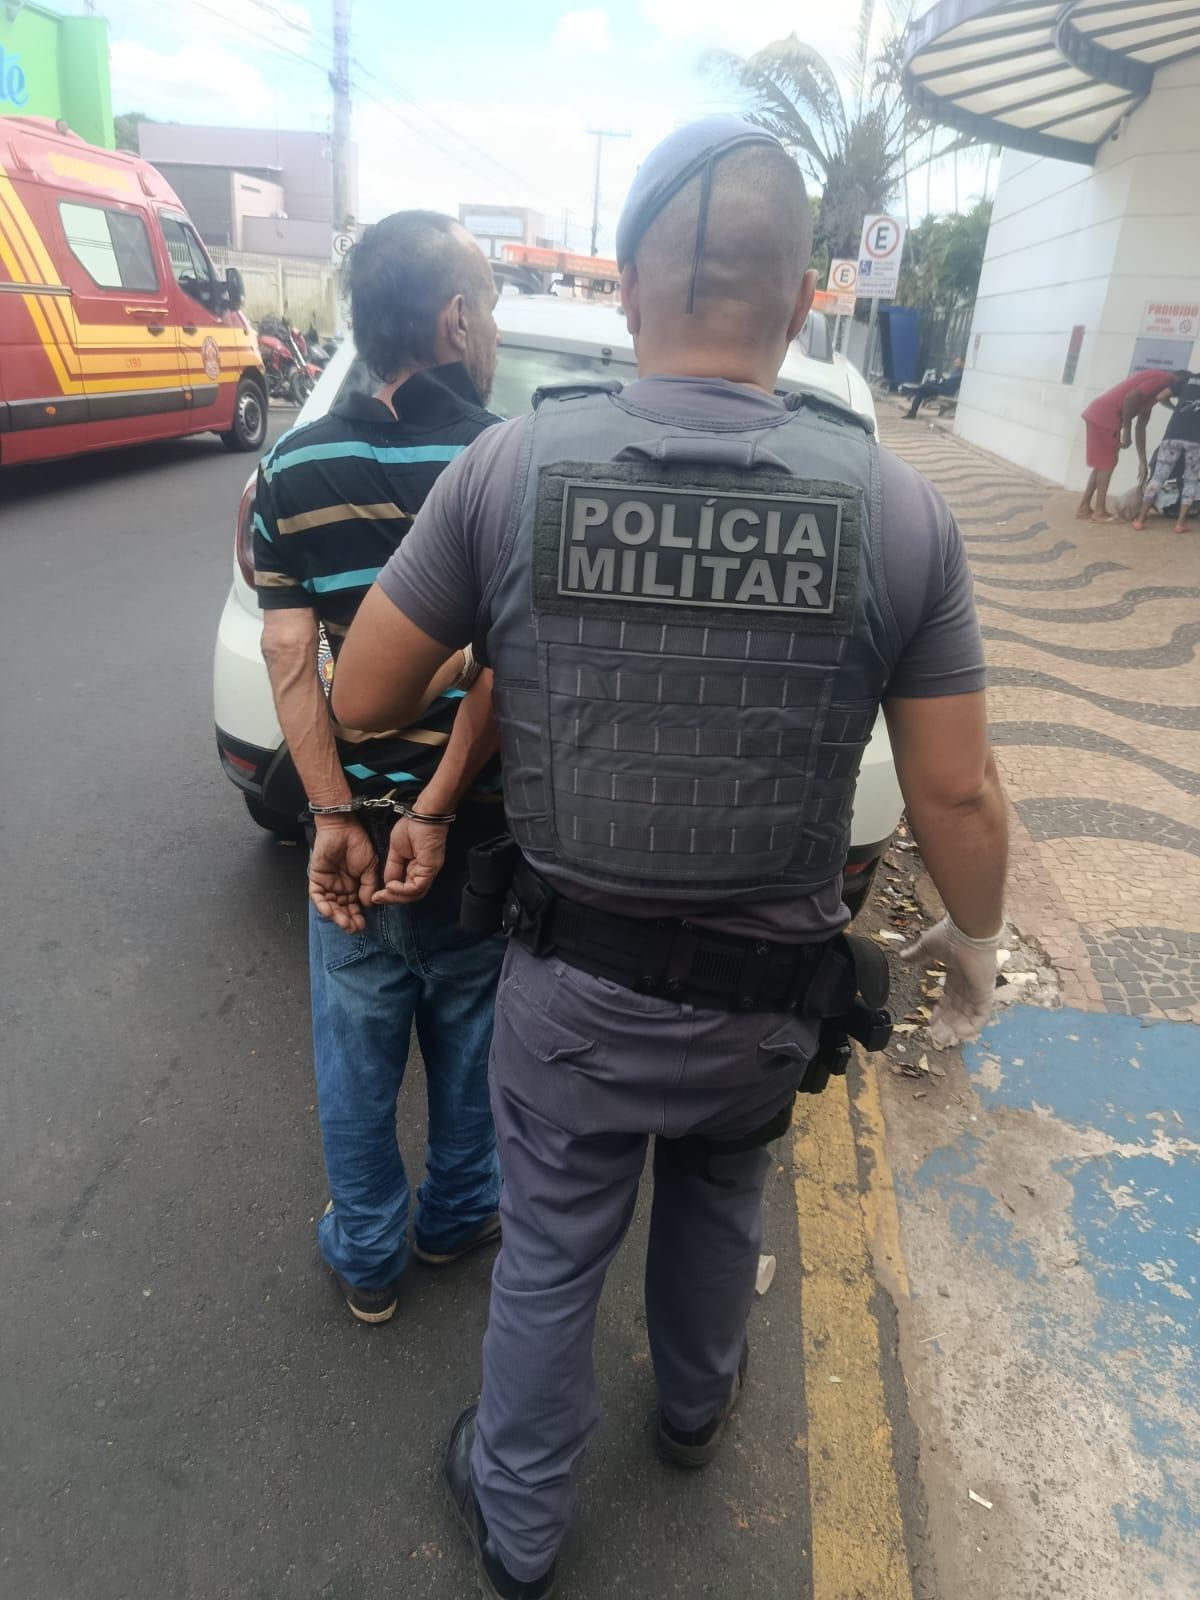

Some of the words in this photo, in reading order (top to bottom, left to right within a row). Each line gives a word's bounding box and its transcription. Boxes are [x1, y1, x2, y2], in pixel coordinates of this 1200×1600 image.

[340, 239, 348, 251] E
[875, 226, 889, 250] E
[840, 268, 850, 283] E
[1147, 303, 1199, 317] PROIBIDO
[571, 496, 826, 558] POLÍCIA
[567, 546, 823, 606] MILITAR
